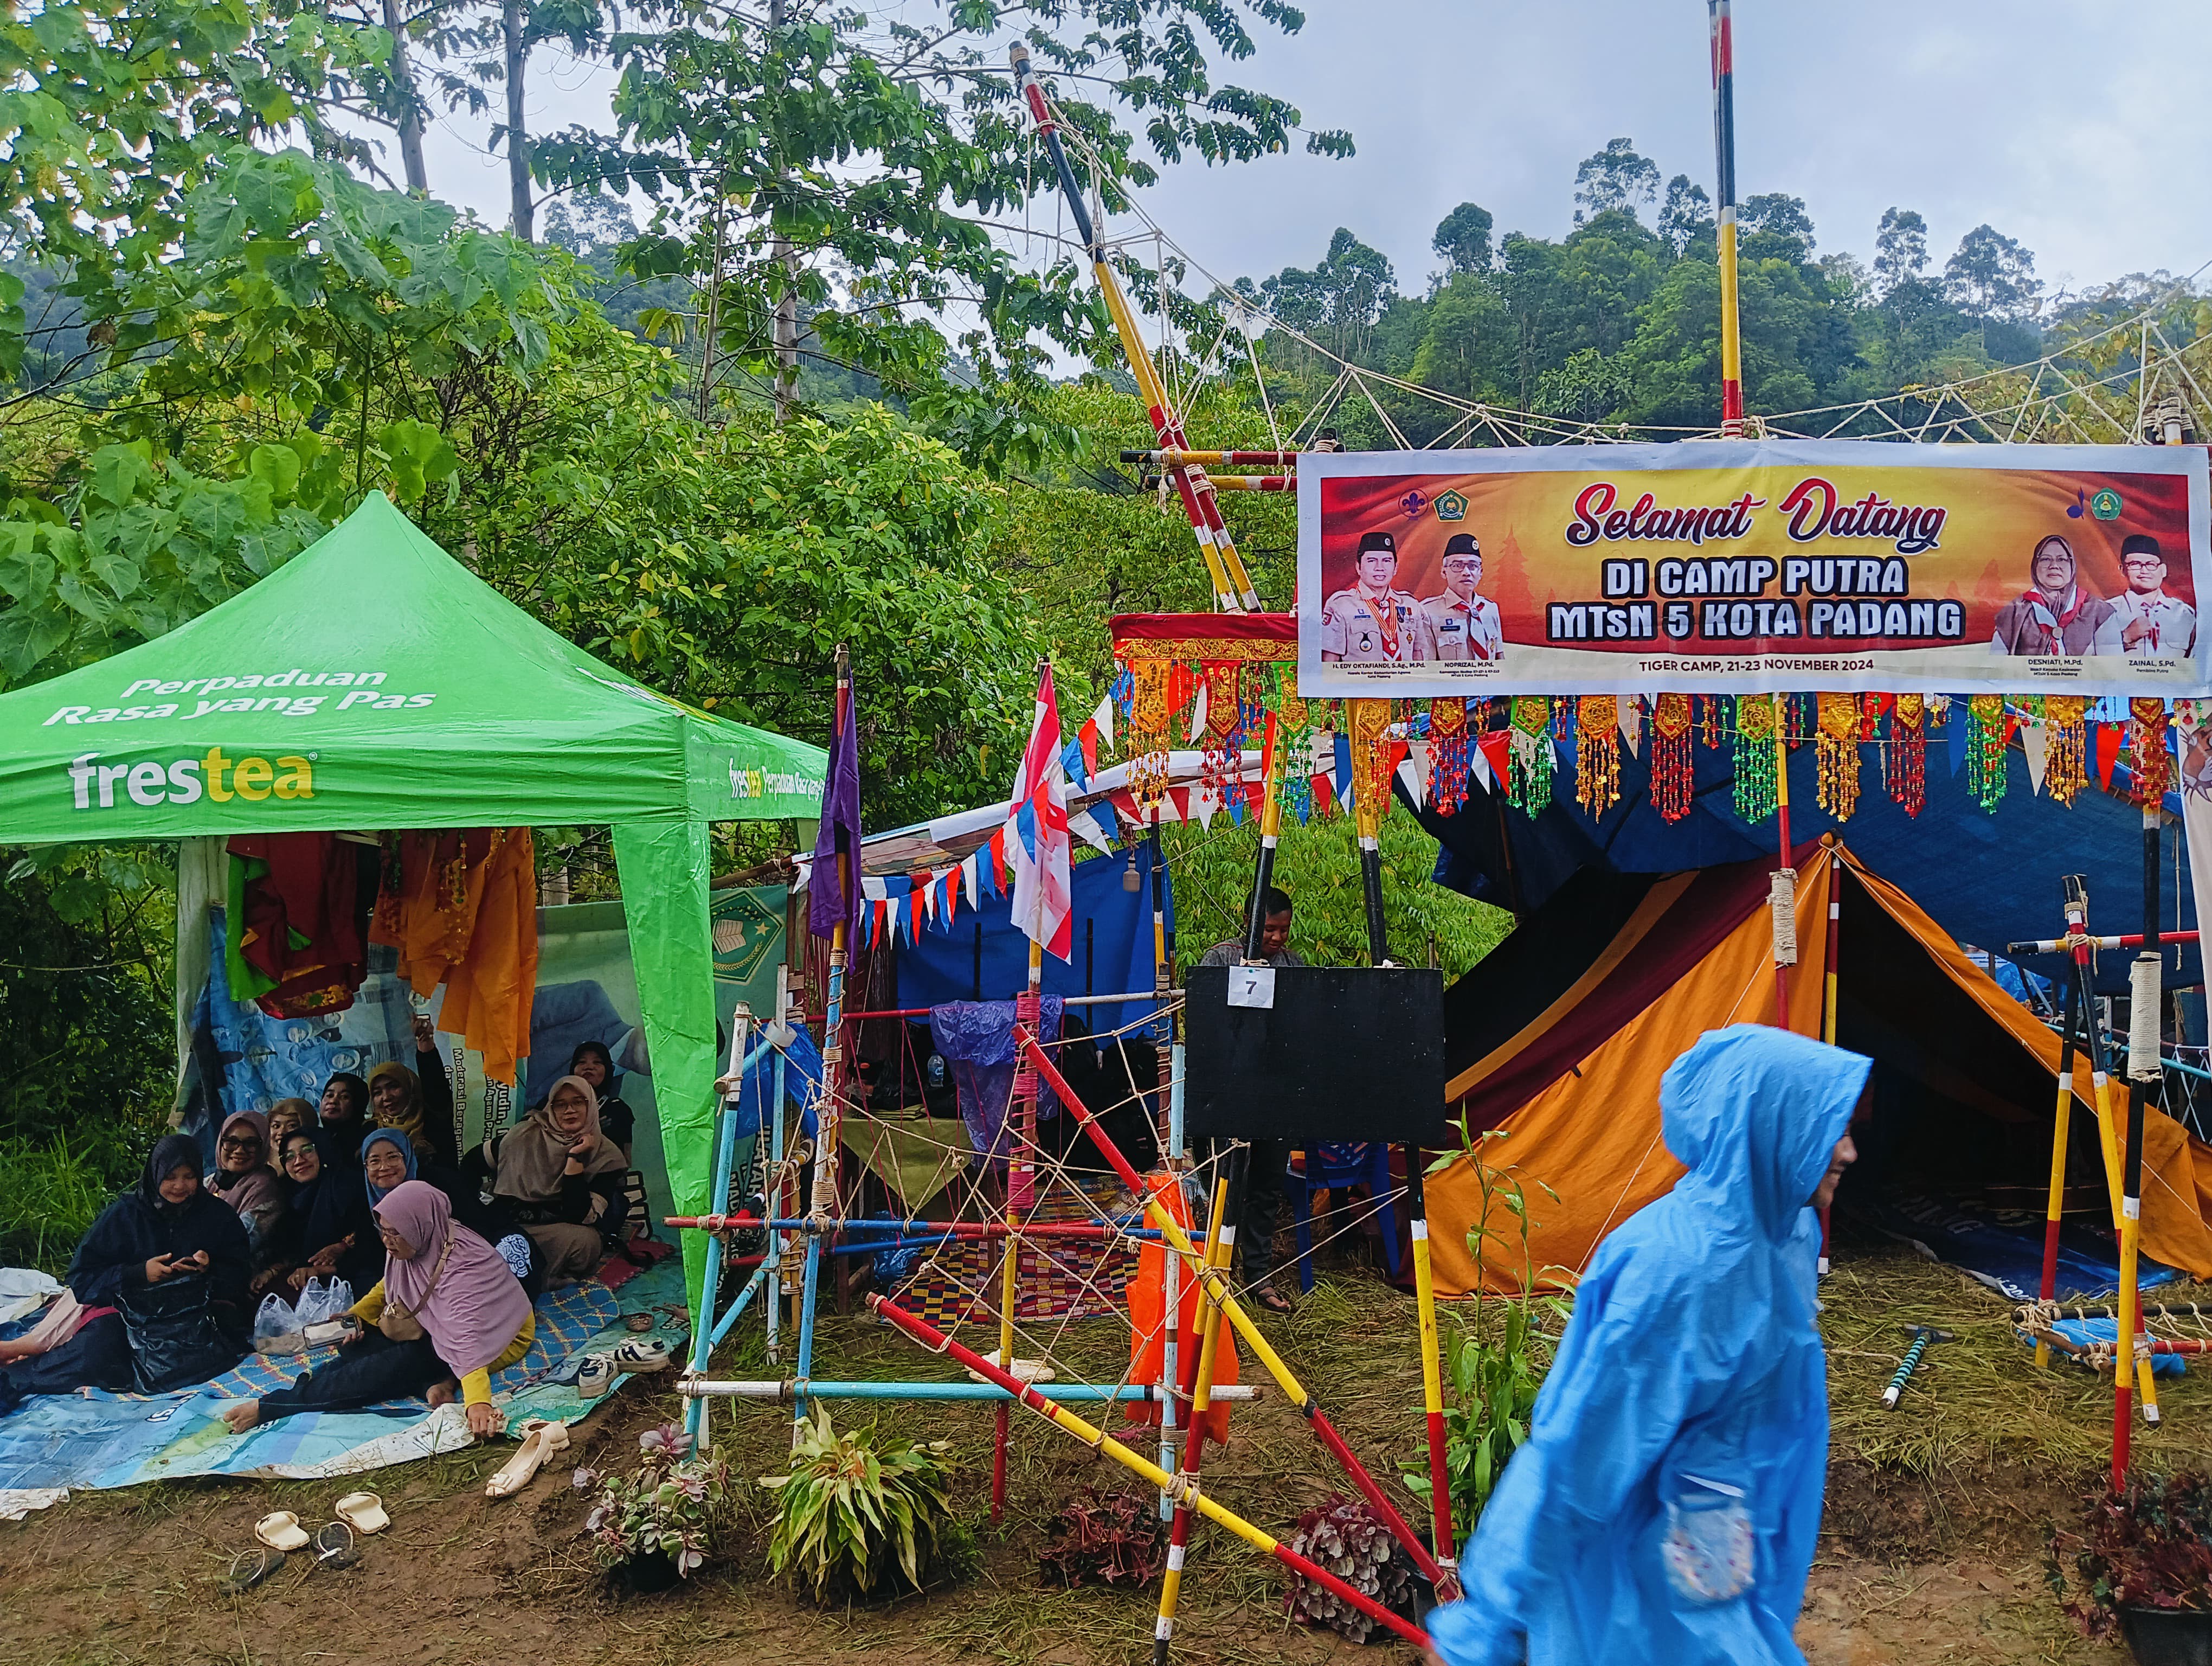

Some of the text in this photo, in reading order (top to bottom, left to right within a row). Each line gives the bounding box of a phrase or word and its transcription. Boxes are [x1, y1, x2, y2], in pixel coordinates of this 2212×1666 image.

[1565, 476, 1948, 555] Selamat Datang
[1605, 558, 1906, 597] DI CAMP PUTRA
[1549, 601, 1963, 640] MTsN 5 KOTA PADANG
[120, 669, 388, 699] Perpaduan
[1638, 659, 1874, 673] TIGER CAMP, 21-23 NOVEMBER 2024
[41, 690, 437, 726] Rasa yang Pas
[68, 746, 316, 810] frestea
[728, 757, 762, 798] frestea
[761, 765, 796, 802] Perpaduan
[794, 771, 809, 794] Rasa
[1245, 981, 1257, 995] 7
[453, 1048, 466, 1098] Moderasi
[484, 1088, 496, 1119] Agama
